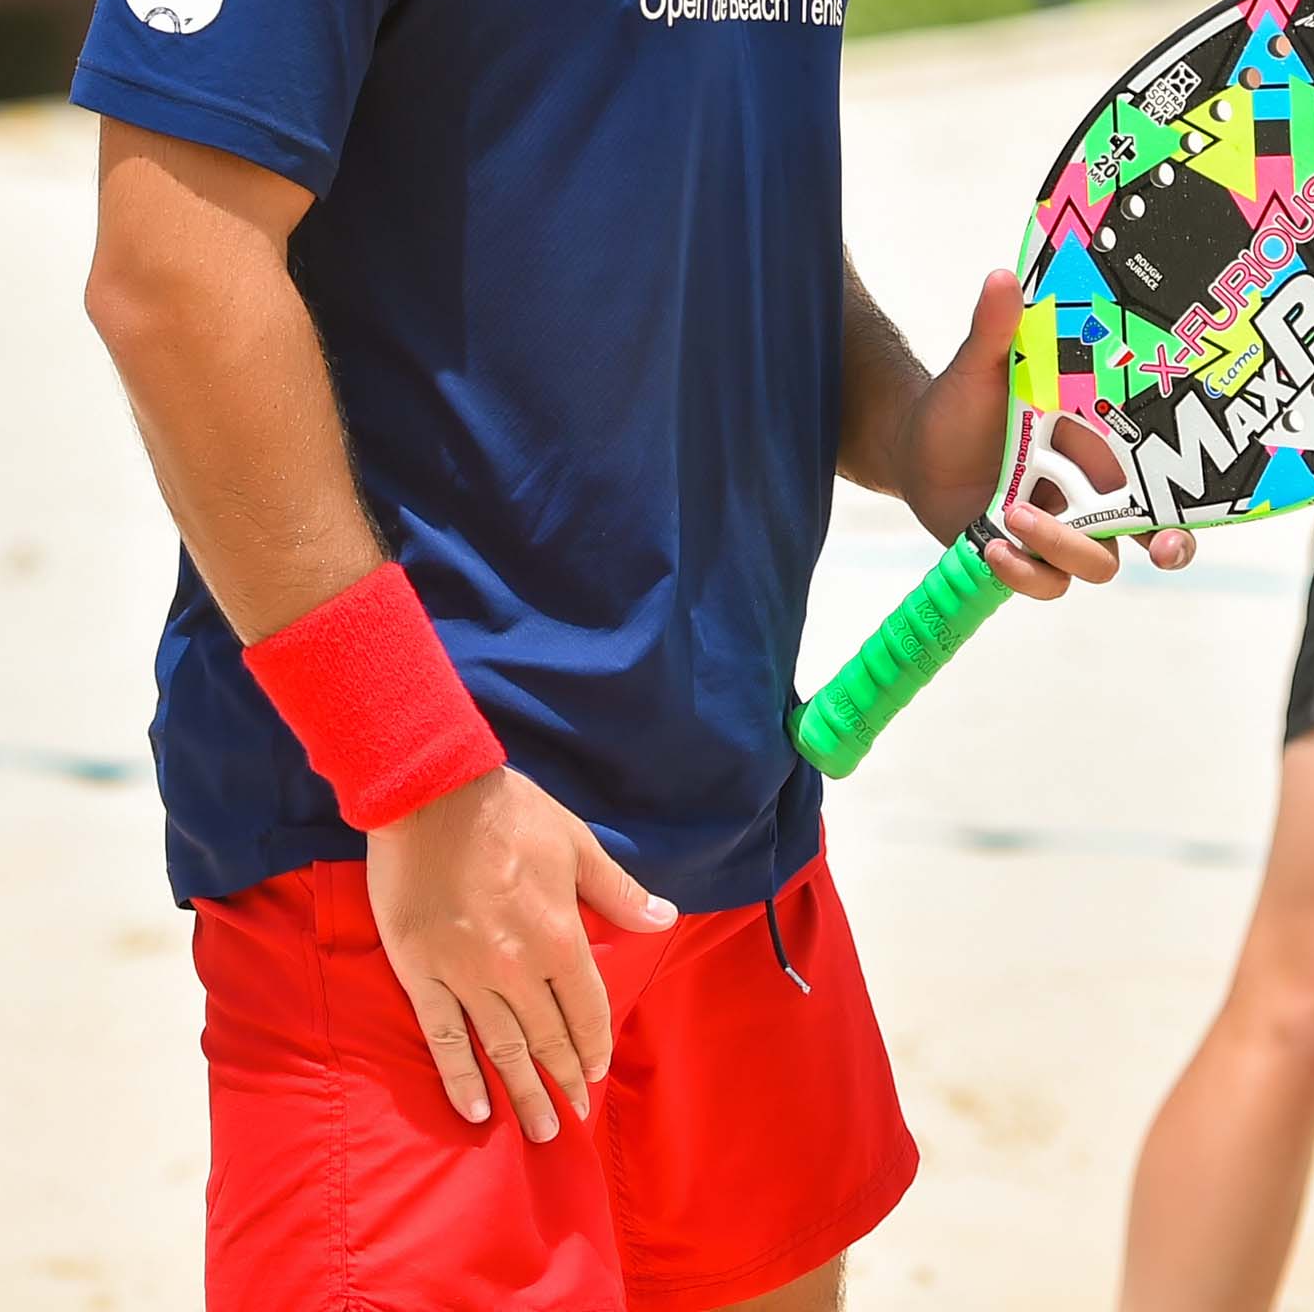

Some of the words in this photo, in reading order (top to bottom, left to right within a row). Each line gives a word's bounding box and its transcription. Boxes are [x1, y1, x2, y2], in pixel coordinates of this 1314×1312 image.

[1148, 88, 1177, 118] SOFT
[1156, 80, 1185, 109] EXTRA
[1142, 102, 1167, 125] EVA
[1094, 155, 1117, 179] 20
[1125, 258, 1159, 291] SURFACE
[1134, 252, 1163, 282] ROUGH
[1016, 410, 1034, 464] Reinforce
[1002, 463, 1027, 511] Structur
[914, 600, 960, 654] KARA
[828, 687, 878, 747] SUPE
